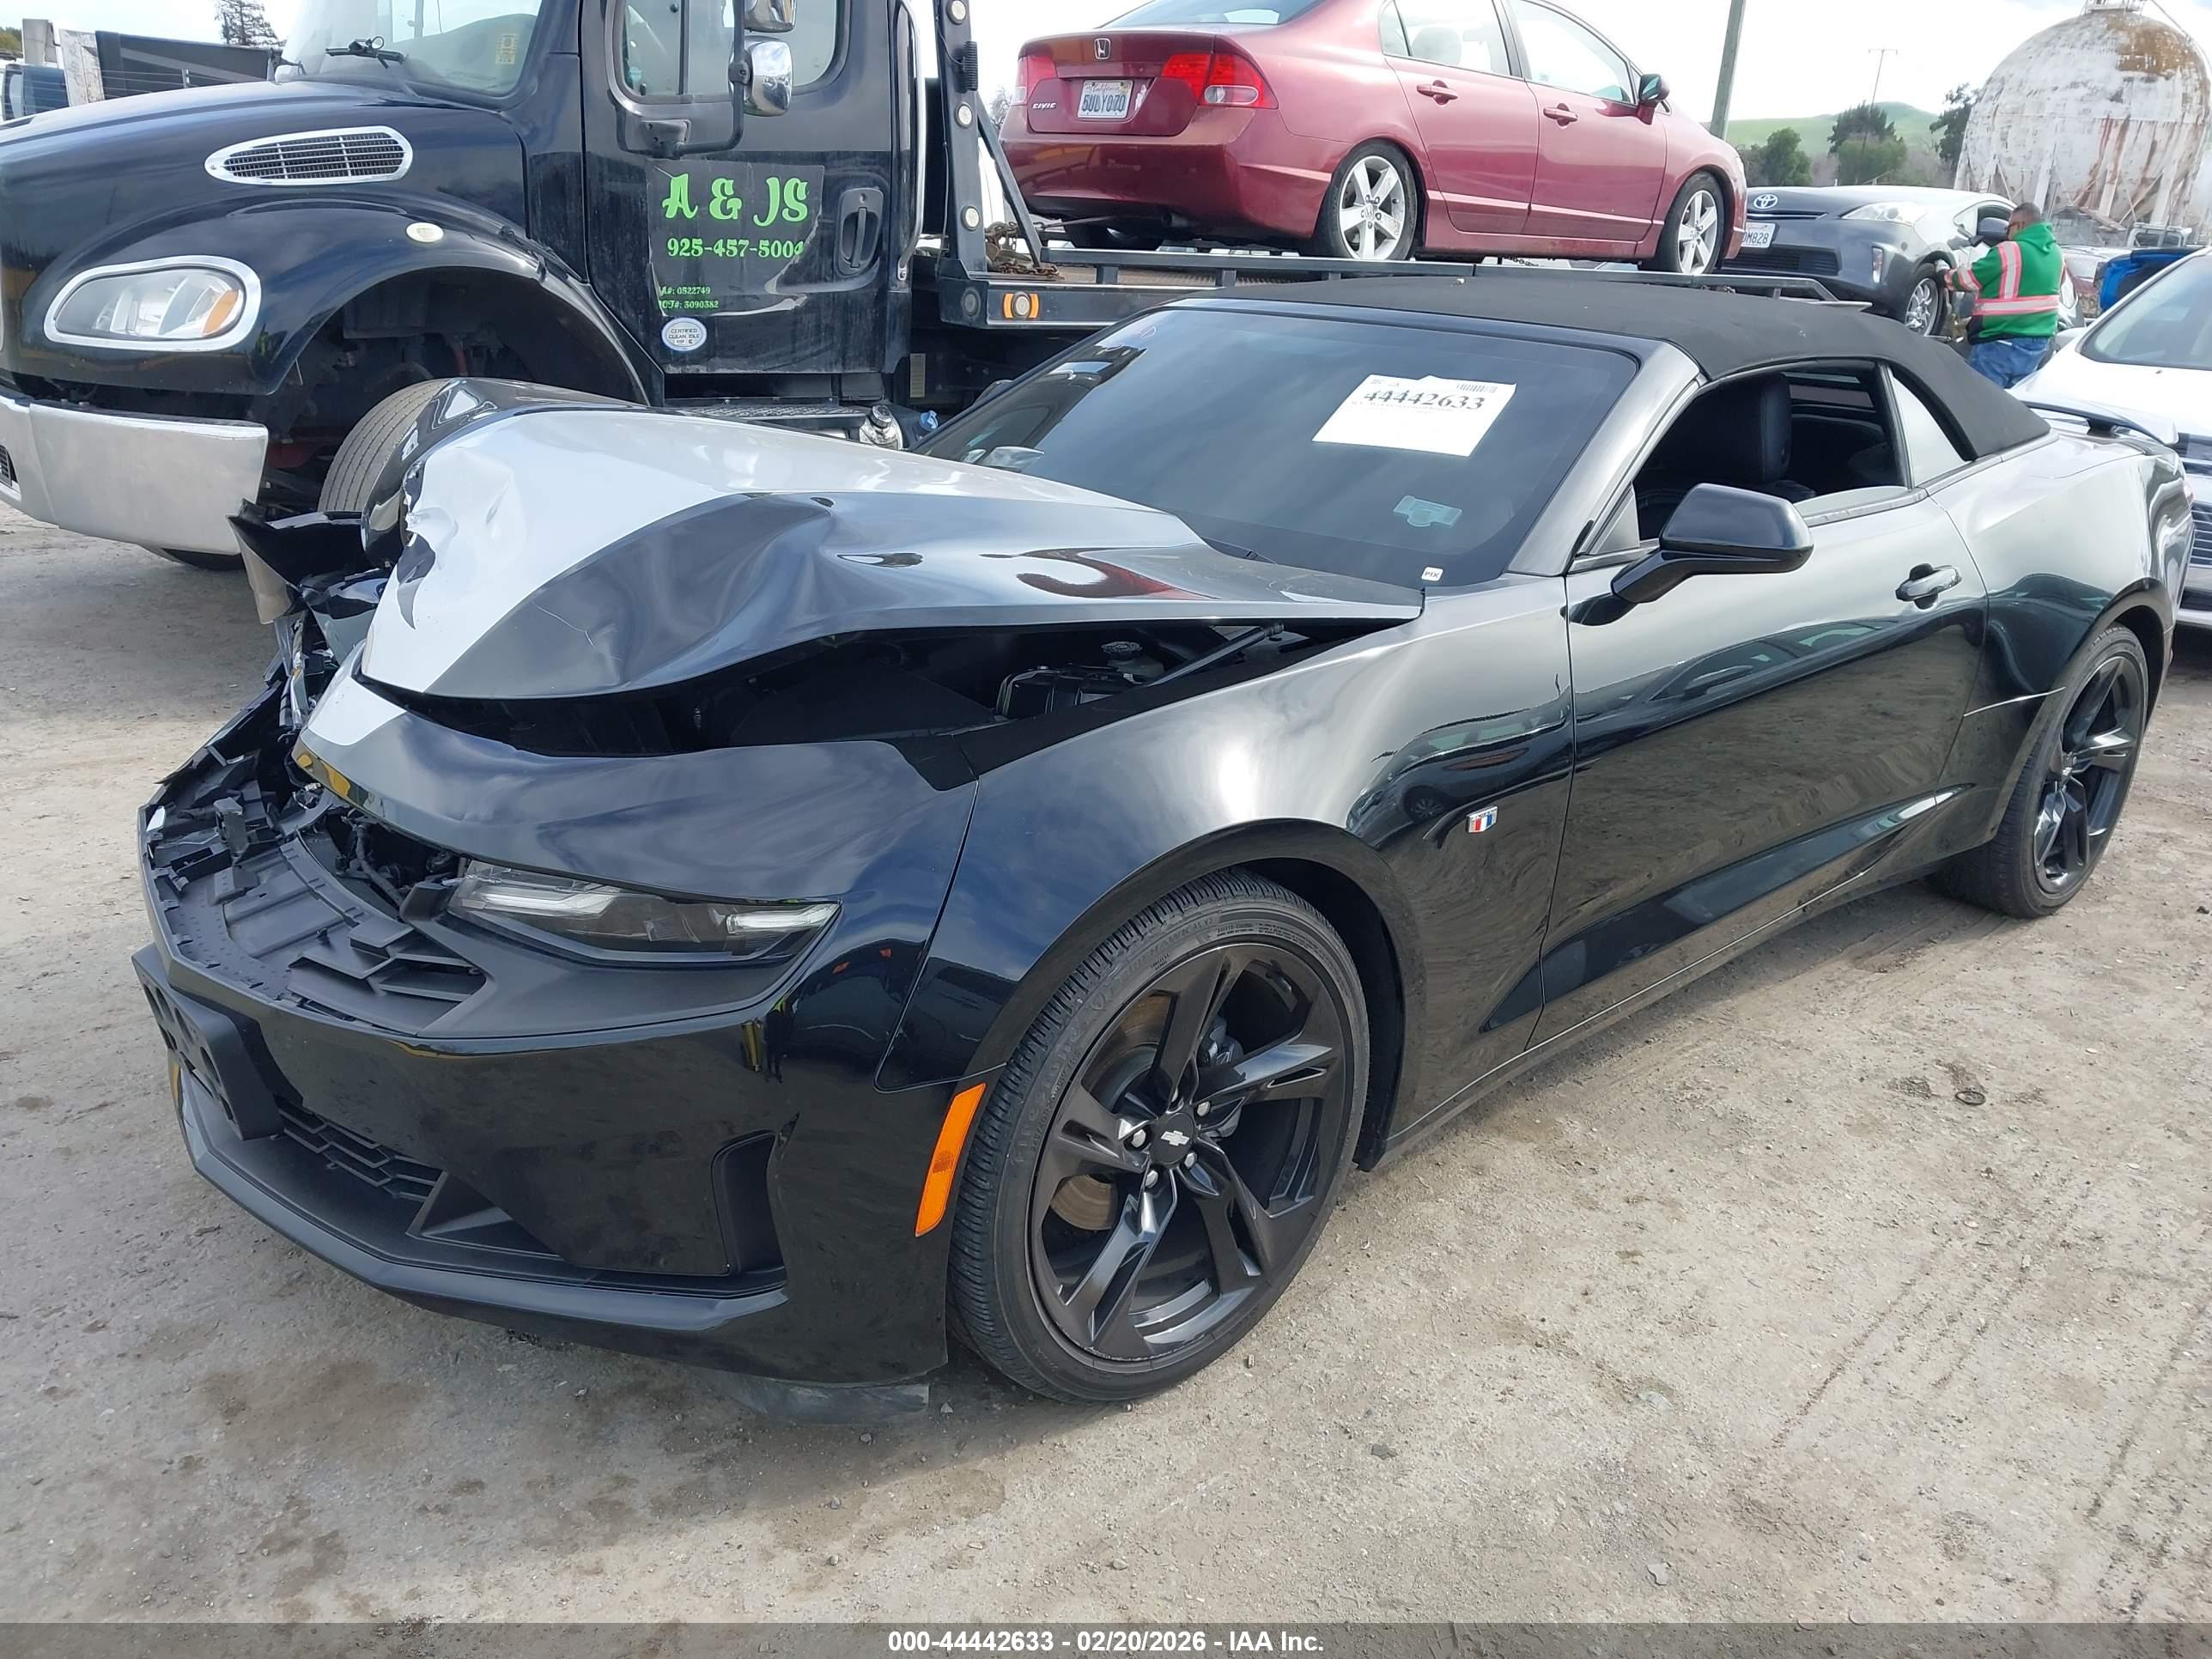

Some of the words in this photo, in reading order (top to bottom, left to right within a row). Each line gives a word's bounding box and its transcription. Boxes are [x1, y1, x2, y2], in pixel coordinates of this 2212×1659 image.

[662, 173, 698, 219] A
[709, 178, 742, 220] &
[753, 177, 809, 227] JS
[684, 300, 720, 308] 3090382
[1364, 389, 1486, 410] 44442633
